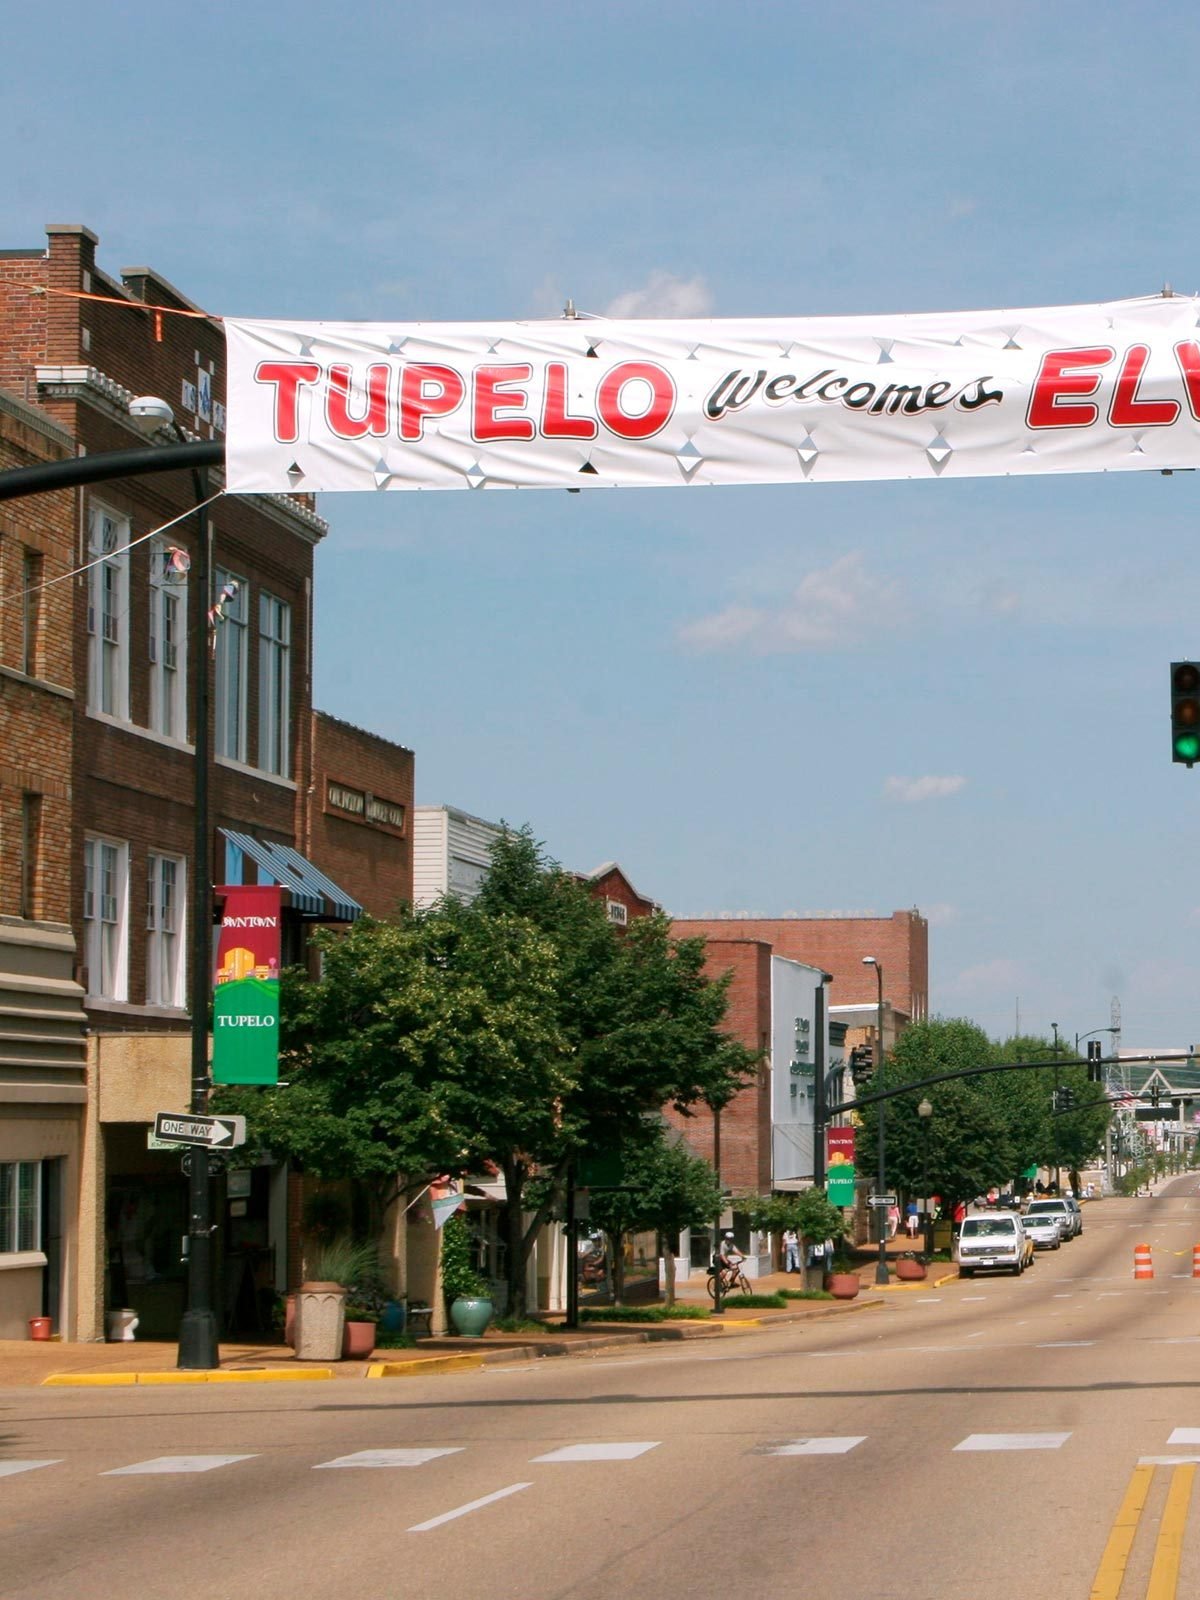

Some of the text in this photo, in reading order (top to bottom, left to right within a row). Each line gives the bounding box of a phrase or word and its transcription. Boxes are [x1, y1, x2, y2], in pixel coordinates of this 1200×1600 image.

[254, 360, 677, 444] TUPELO
[702, 369, 1004, 421] Welcomes
[218, 1015, 275, 1027] TUPELO
[163, 1121, 213, 1136] ONE WAY
